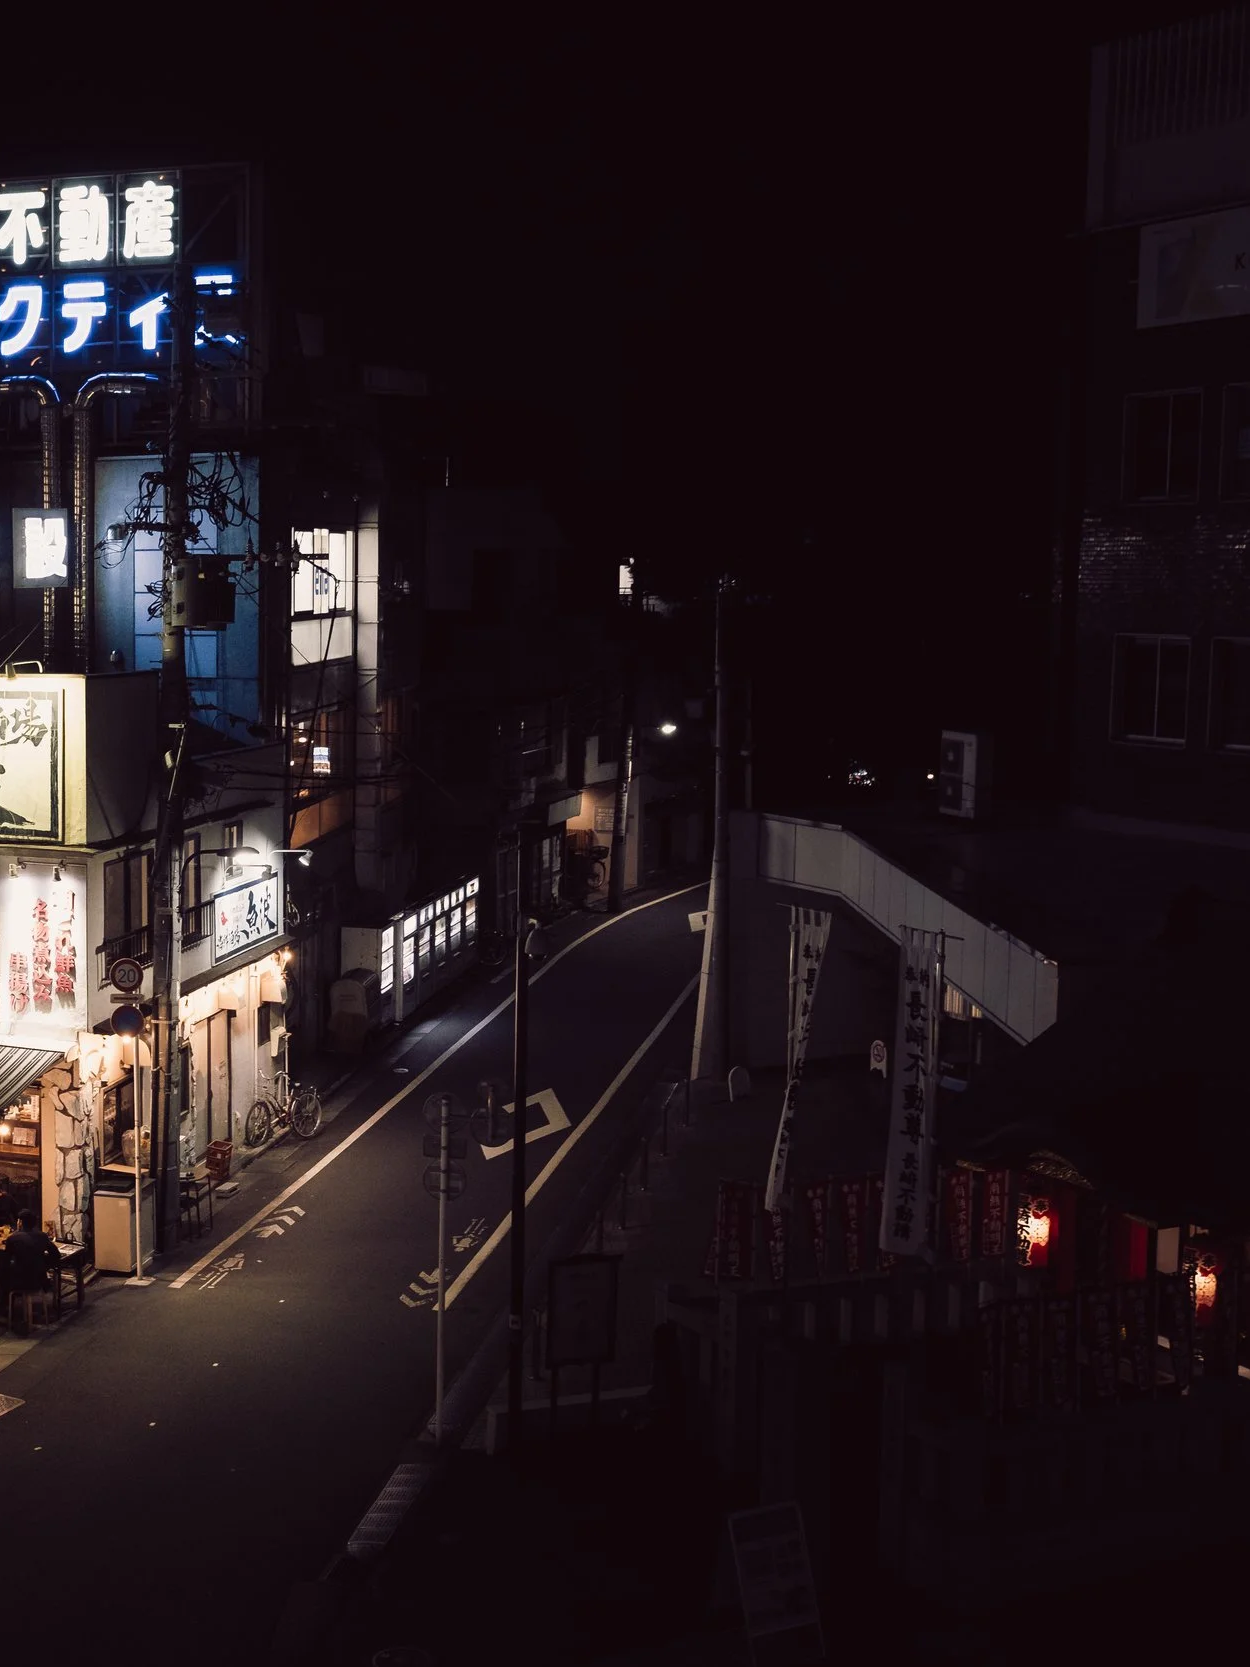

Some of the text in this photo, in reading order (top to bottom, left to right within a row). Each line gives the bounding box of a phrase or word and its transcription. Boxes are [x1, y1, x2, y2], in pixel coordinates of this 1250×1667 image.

[9, 952, 30, 1015] 串揚げ
[118, 968, 136, 983] 20
